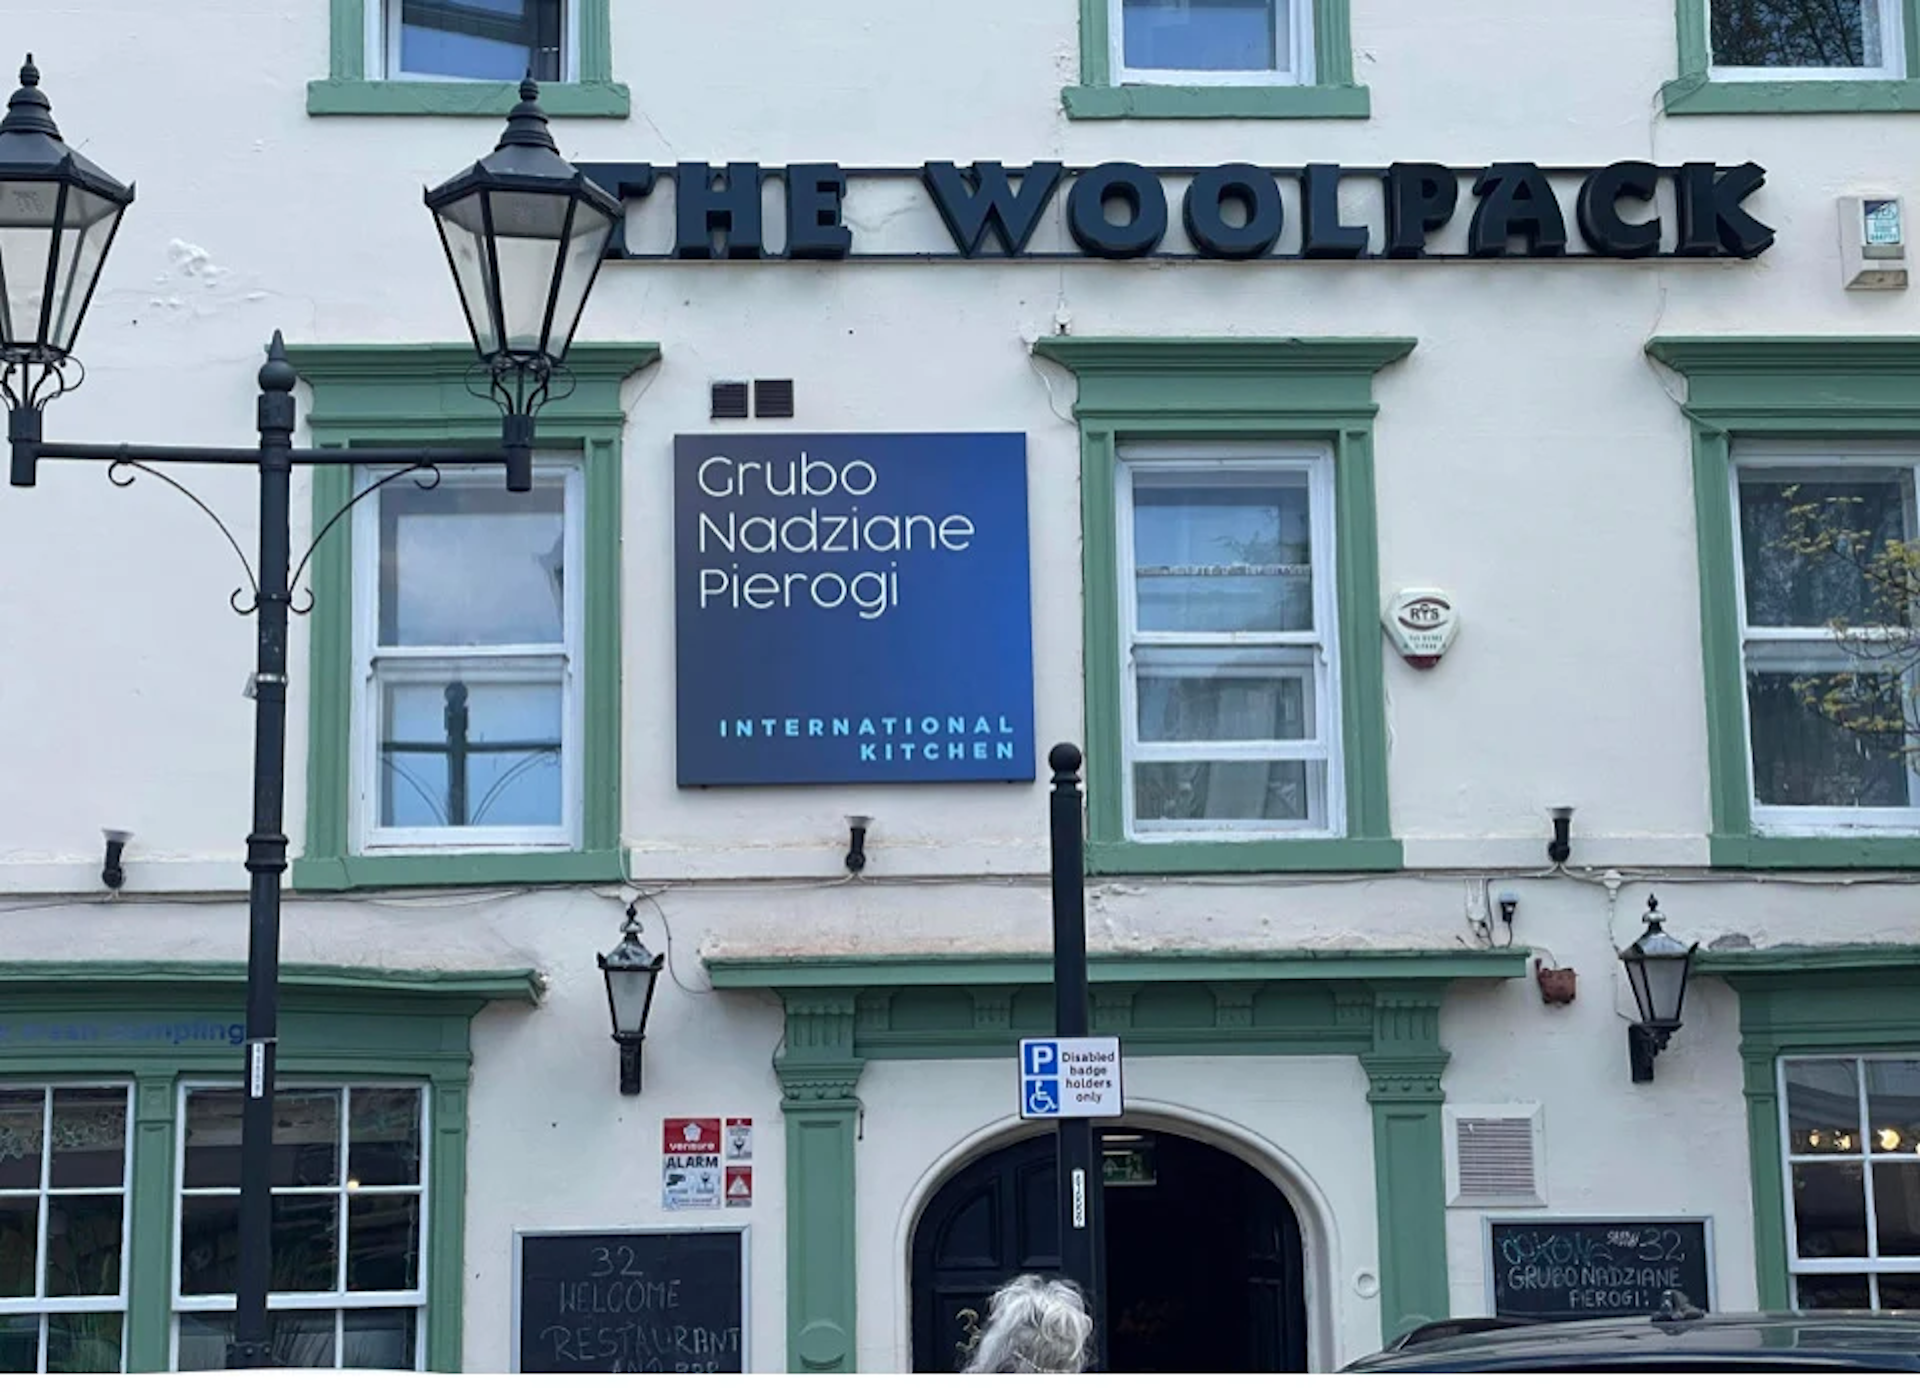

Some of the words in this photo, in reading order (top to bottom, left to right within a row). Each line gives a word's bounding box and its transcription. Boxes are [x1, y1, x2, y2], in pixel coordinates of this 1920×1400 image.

[572, 162, 852, 259] THE
[922, 160, 1776, 259] WOOLPACK
[698, 452, 878, 497] Grubo
[699, 506, 976, 553] Nadziane
[700, 561, 898, 619] Pierogi
[719, 716, 1014, 738] INTERNATIONAL
[860, 742, 1014, 761] KITCHEN
[1033, 1045, 1054, 1074] P
[1062, 1051, 1115, 1063] Disabled
[1065, 1078, 1112, 1089] holders
[1070, 1065, 1107, 1077] badge
[1075, 1091, 1102, 1104] only
[666, 1155, 719, 1169] ALARM
[590, 1245, 644, 1277] 32
[1507, 1265, 1579, 1290] GRUBO
[1580, 1264, 1683, 1289] NADZIANE
[558, 1278, 682, 1314] WELCOME
[539, 1320, 742, 1362] RESTAURANT
